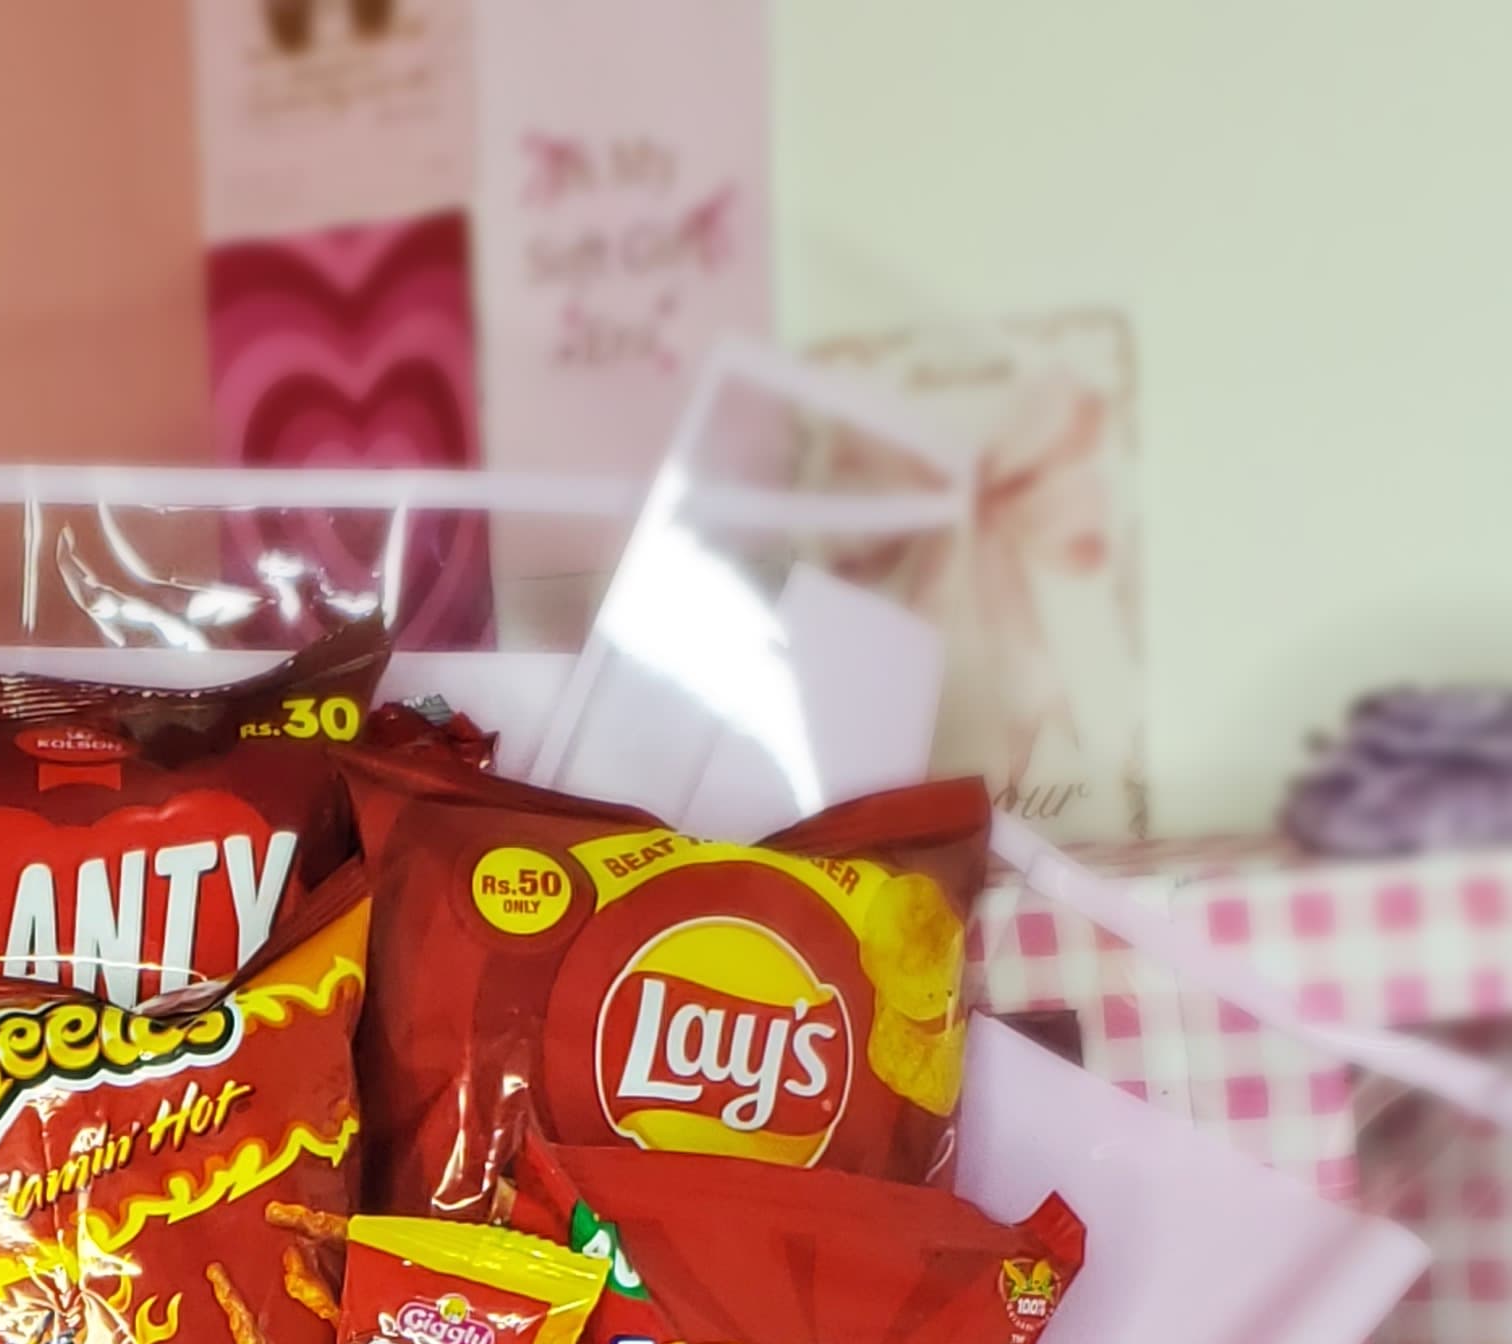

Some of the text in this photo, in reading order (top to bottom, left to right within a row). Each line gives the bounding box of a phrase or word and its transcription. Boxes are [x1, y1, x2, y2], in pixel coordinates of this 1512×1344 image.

[602, 838, 677, 879] BEAT
[481, 868, 562, 897] Rs.50
[503, 900, 541, 914] ONLY
[617, 978, 836, 1132] Lay's
[148, 1080, 252, 1150] Hot
